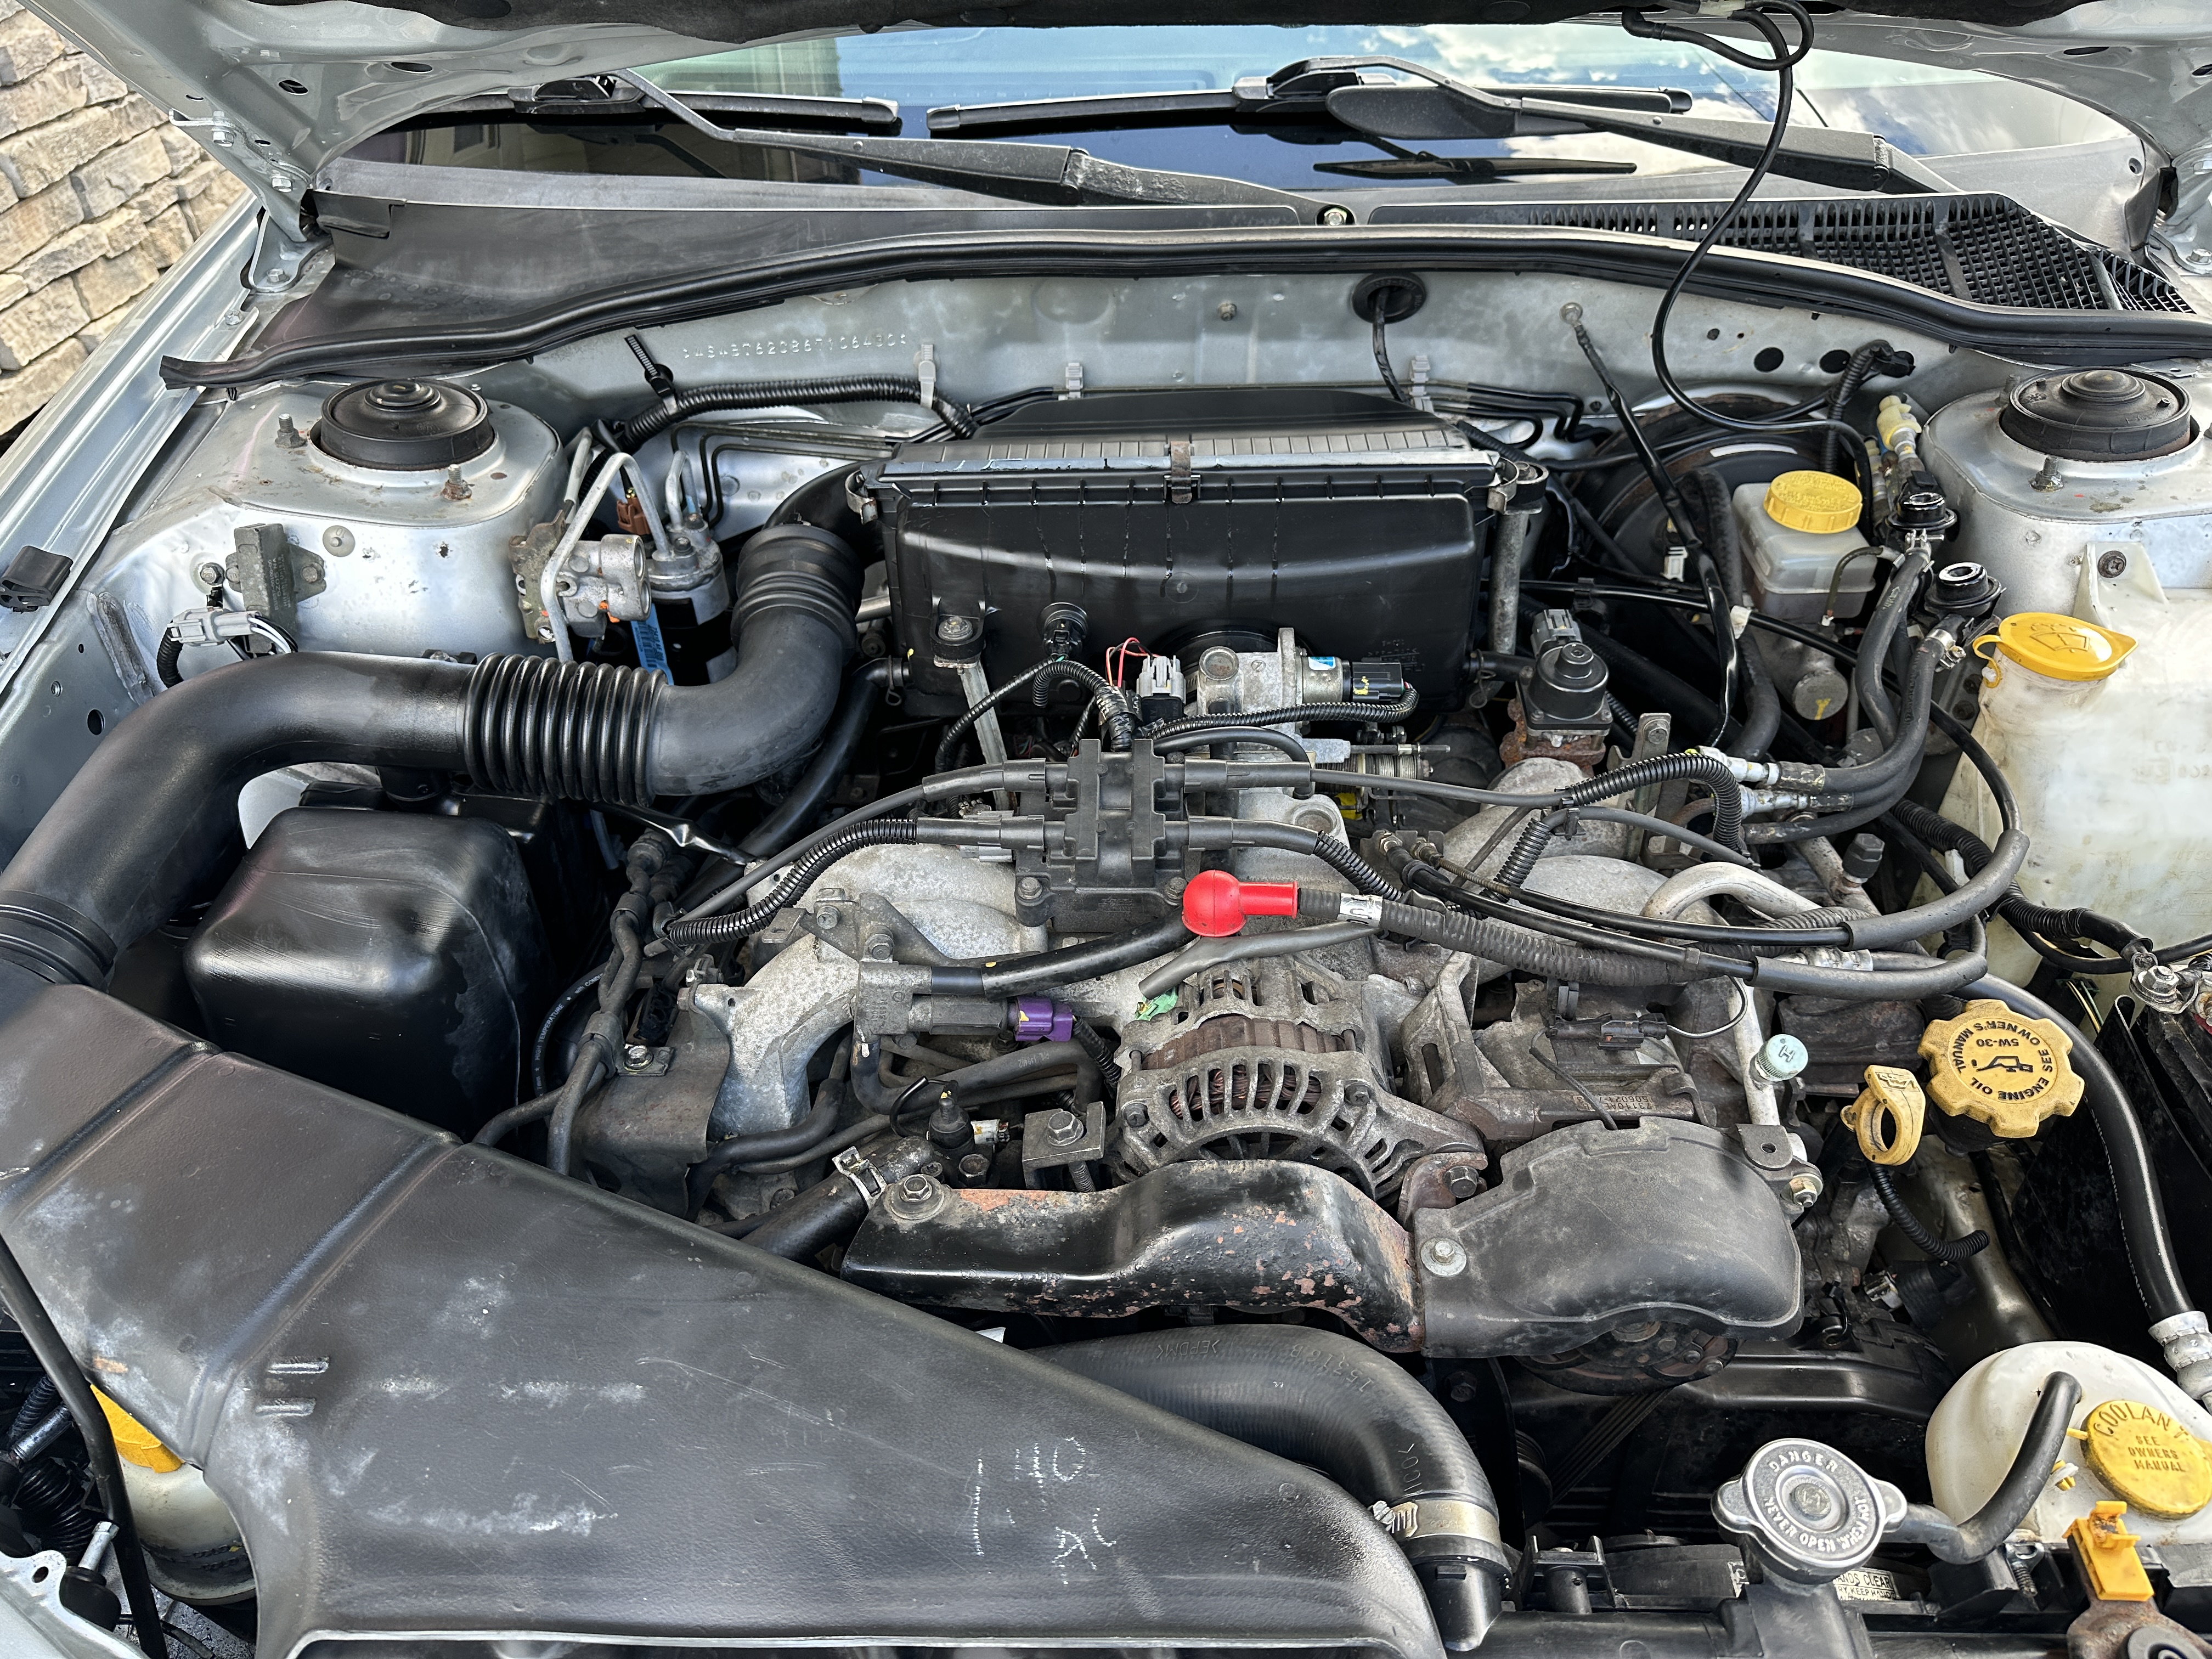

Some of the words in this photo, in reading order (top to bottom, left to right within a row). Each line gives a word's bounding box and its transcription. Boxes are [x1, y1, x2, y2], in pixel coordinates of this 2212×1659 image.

[538, 1003, 565, 1042] TEMPERATURE
[1973, 1020, 2040, 1046] OWNER'S
[1953, 1028, 1974, 1074] MANUAL
[1976, 1039, 2019, 1047] 5W-30
[2038, 1048, 2053, 1073] SEE
[1970, 1076, 1993, 1094] OIL
[1997, 1076, 2050, 1101] ENGINE
[2093, 1402, 2189, 1439] COOLANT
[2135, 1435, 2160, 1446] SEE
[1768, 1451, 1838, 1472] DANGER
[2128, 1447, 2179, 1460] OWNERS
[2134, 1459, 2186, 1472] MANUAL
[1763, 1497, 1798, 1537] NEVER
[1799, 1533, 1836, 1553] OPEN
[1836, 1521, 1867, 1550] WHEN
[1853, 1497, 1870, 1521] HOT
[1850, 1587, 1869, 1596] KEEP
[1863, 1574, 1894, 1590] CLEAR
